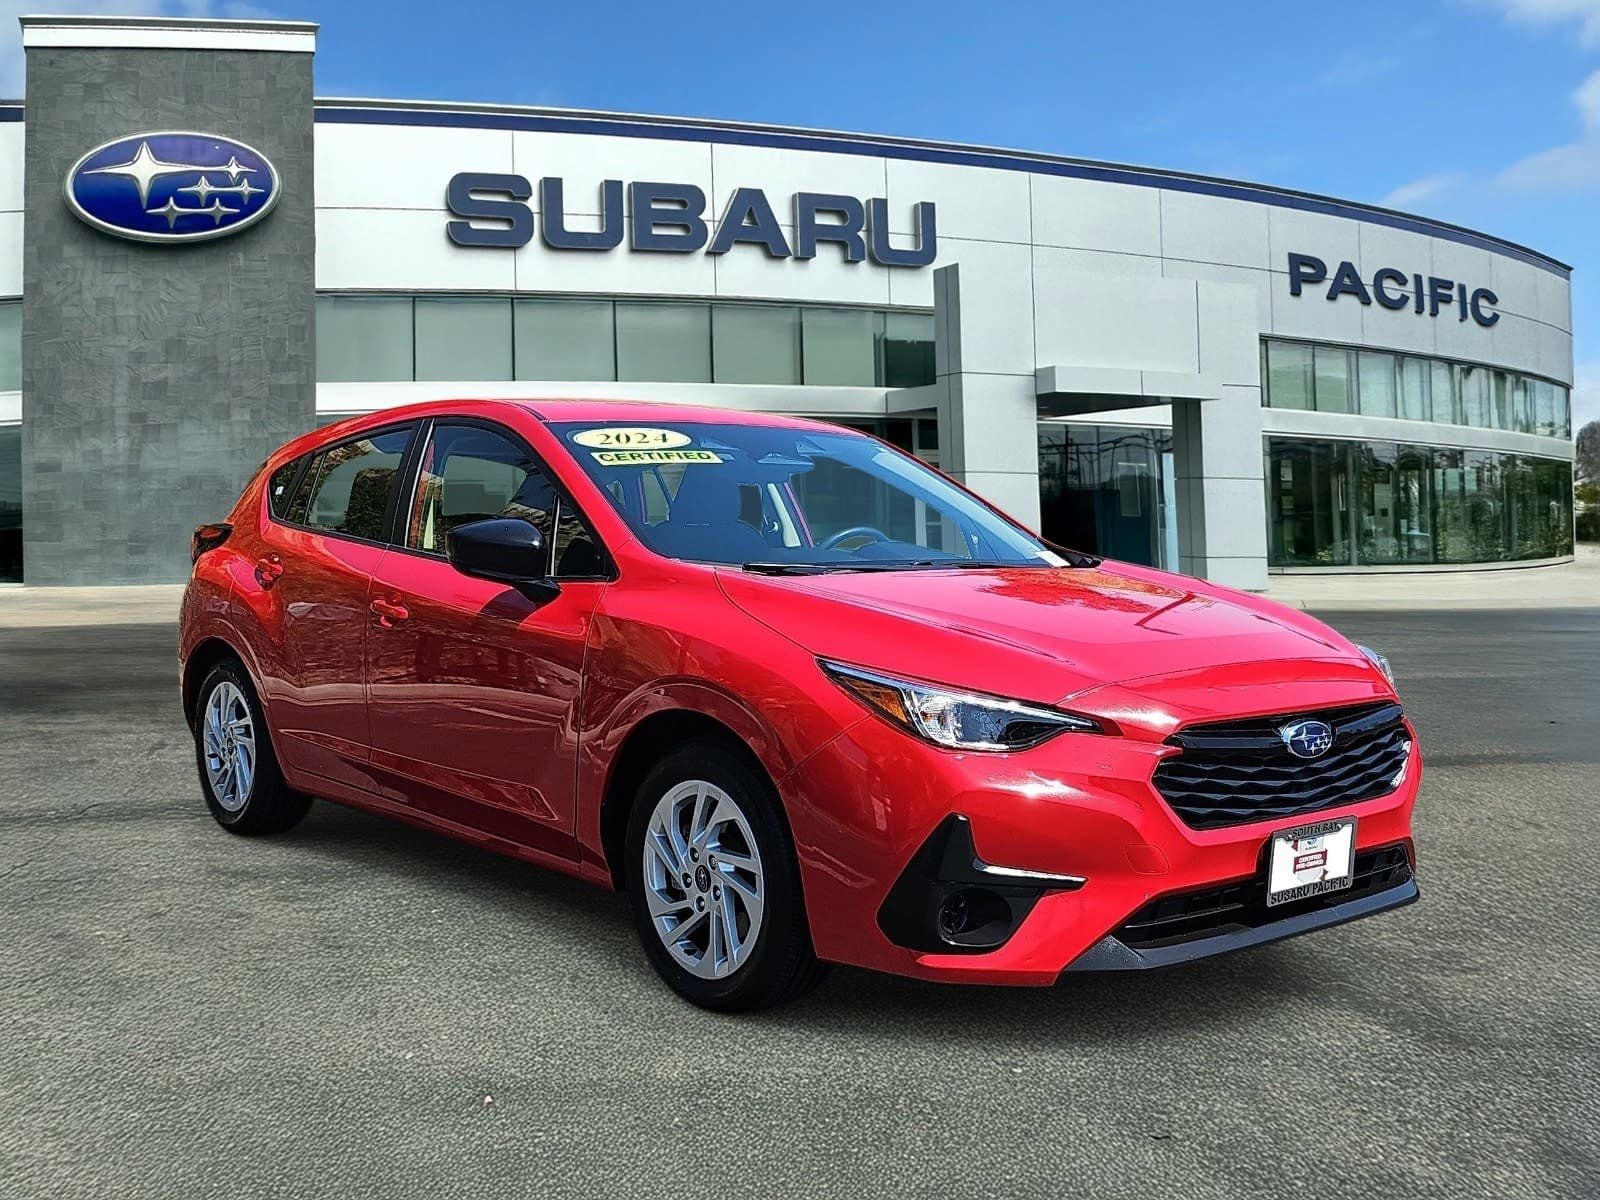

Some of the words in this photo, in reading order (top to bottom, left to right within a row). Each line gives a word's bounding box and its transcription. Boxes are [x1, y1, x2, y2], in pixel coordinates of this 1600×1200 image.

[447, 171, 937, 267] SUBARU
[1288, 252, 1500, 327] PACIFIC
[599, 432, 669, 445] 2024
[599, 451, 711, 462] CERTIFIED
[1292, 824, 1321, 838] SOUTH
[1271, 885, 1311, 904] SUBARU
[1312, 877, 1350, 894] PACIFIC
